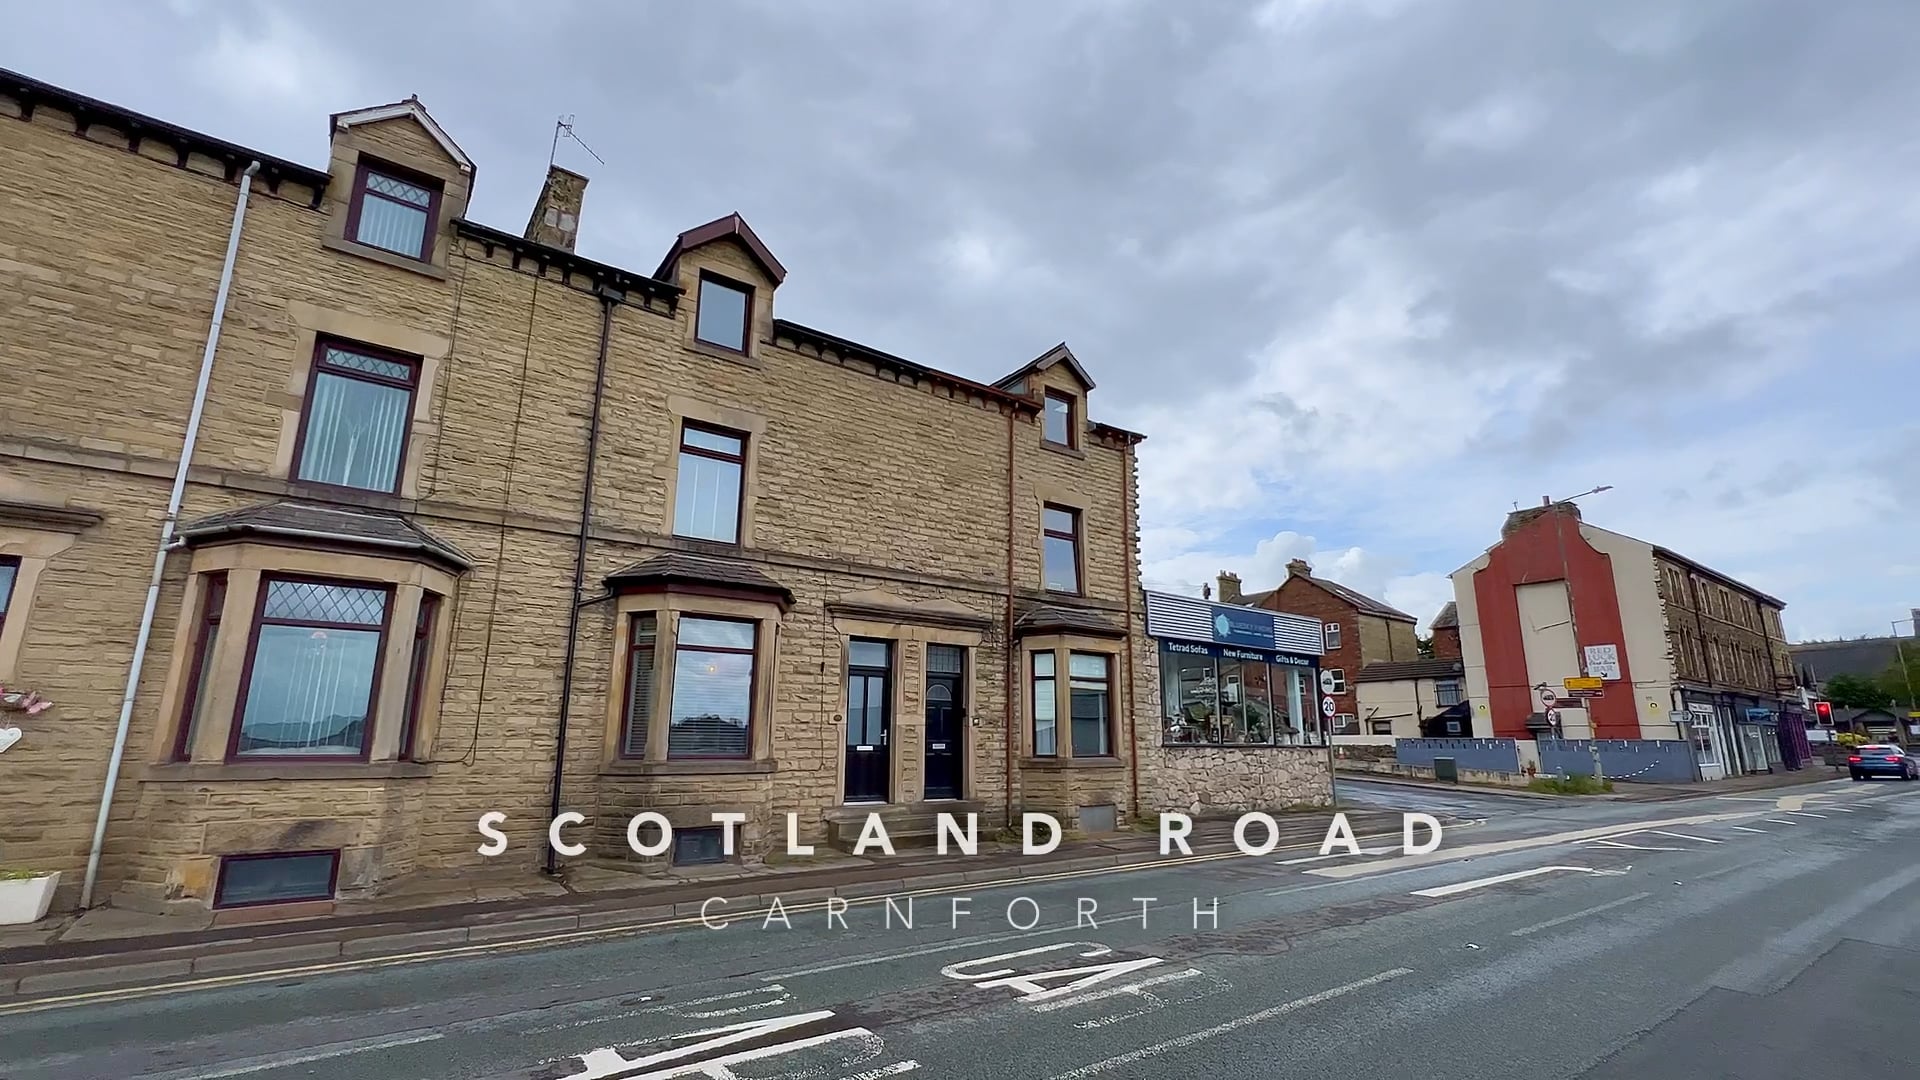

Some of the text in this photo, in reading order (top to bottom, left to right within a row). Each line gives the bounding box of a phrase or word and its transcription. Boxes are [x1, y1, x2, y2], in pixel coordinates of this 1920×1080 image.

[1168, 641, 1209, 655] Tetrad Sofas
[1223, 648, 1263, 661] New Furniture
[1275, 654, 1290, 664] Gifts
[1323, 701, 1335, 712] 20
